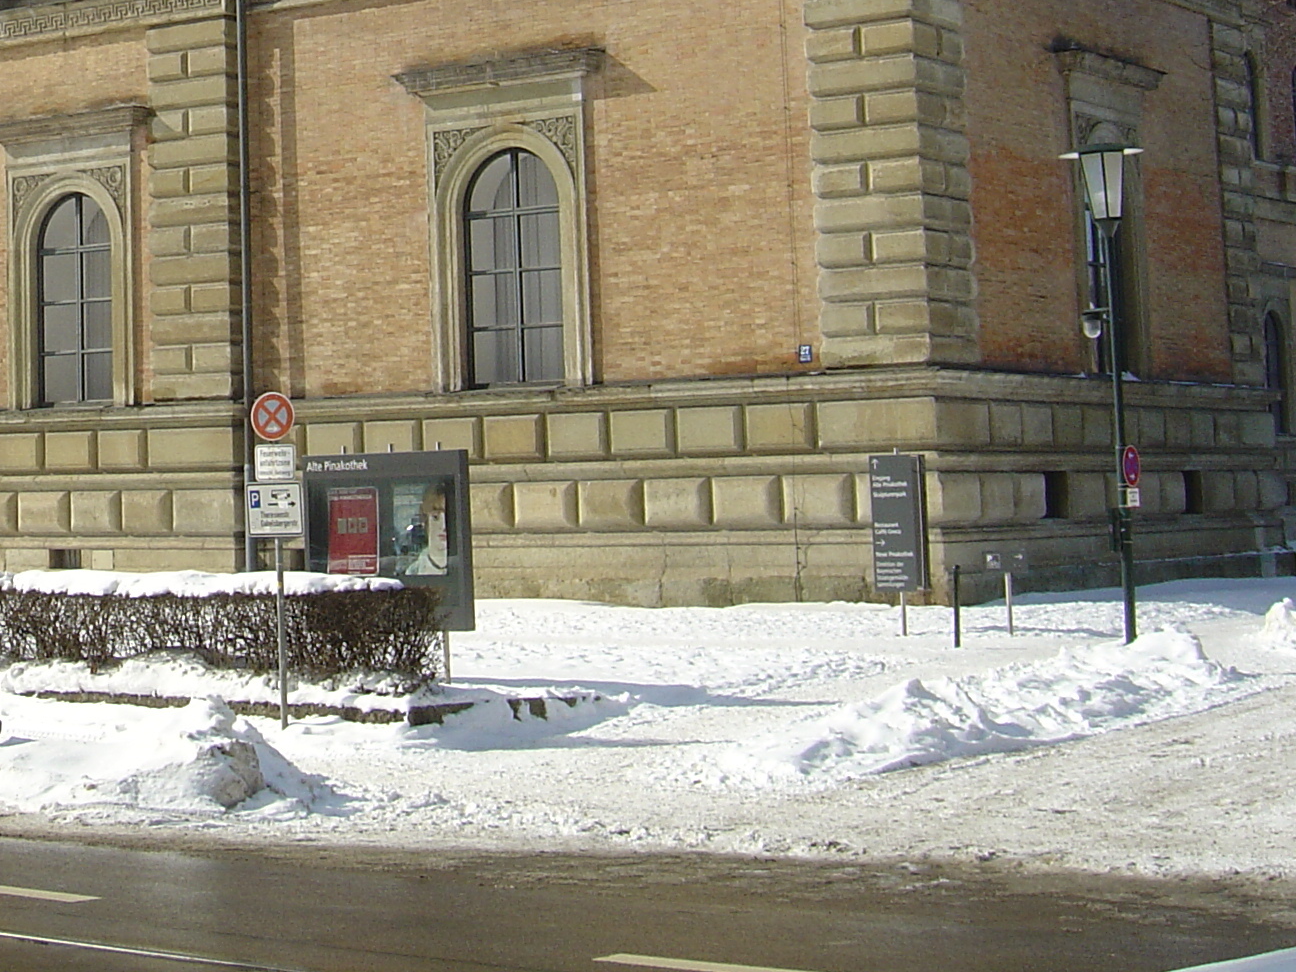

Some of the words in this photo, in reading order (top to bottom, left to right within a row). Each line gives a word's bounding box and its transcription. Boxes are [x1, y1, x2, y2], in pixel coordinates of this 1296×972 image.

[306, 461, 323, 472] Alte
[324, 458, 368, 471] Pinakothek
[251, 492, 259, 507] P
